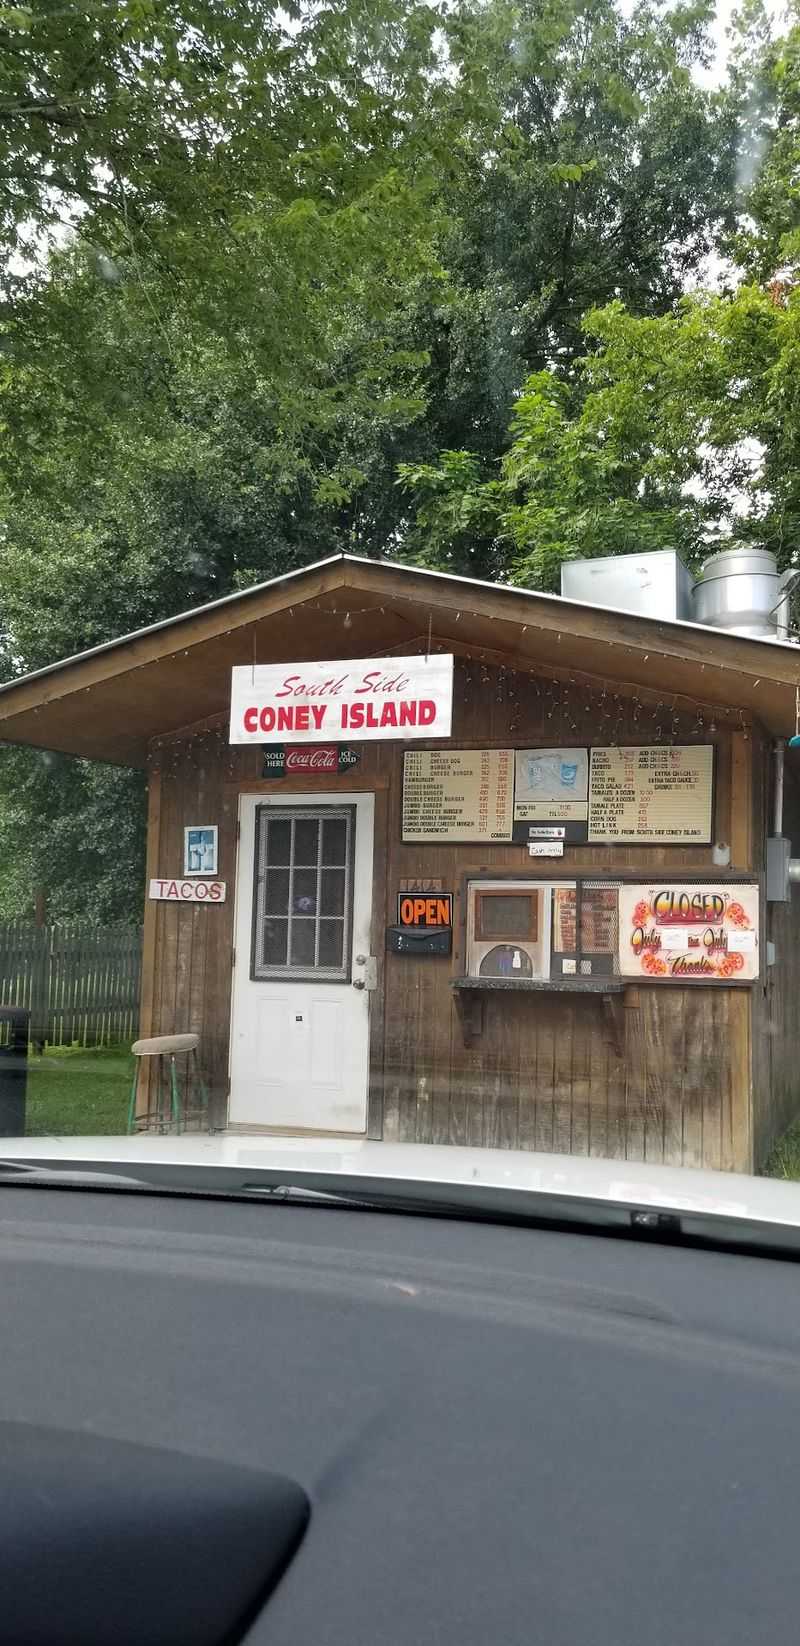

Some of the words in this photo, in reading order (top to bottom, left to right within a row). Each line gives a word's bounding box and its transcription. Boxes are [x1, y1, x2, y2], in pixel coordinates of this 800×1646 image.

[275, 674, 349, 698] South
[354, 671, 410, 694] Side
[243, 704, 327, 733] CONEY
[341, 700, 437, 729] ISLAND
[286, 750, 335, 768] Coca-Cola
[156, 881, 222, 900] TACOS
[401, 898, 450, 925] OPEN
[653, 891, 724, 920] CLOSED
